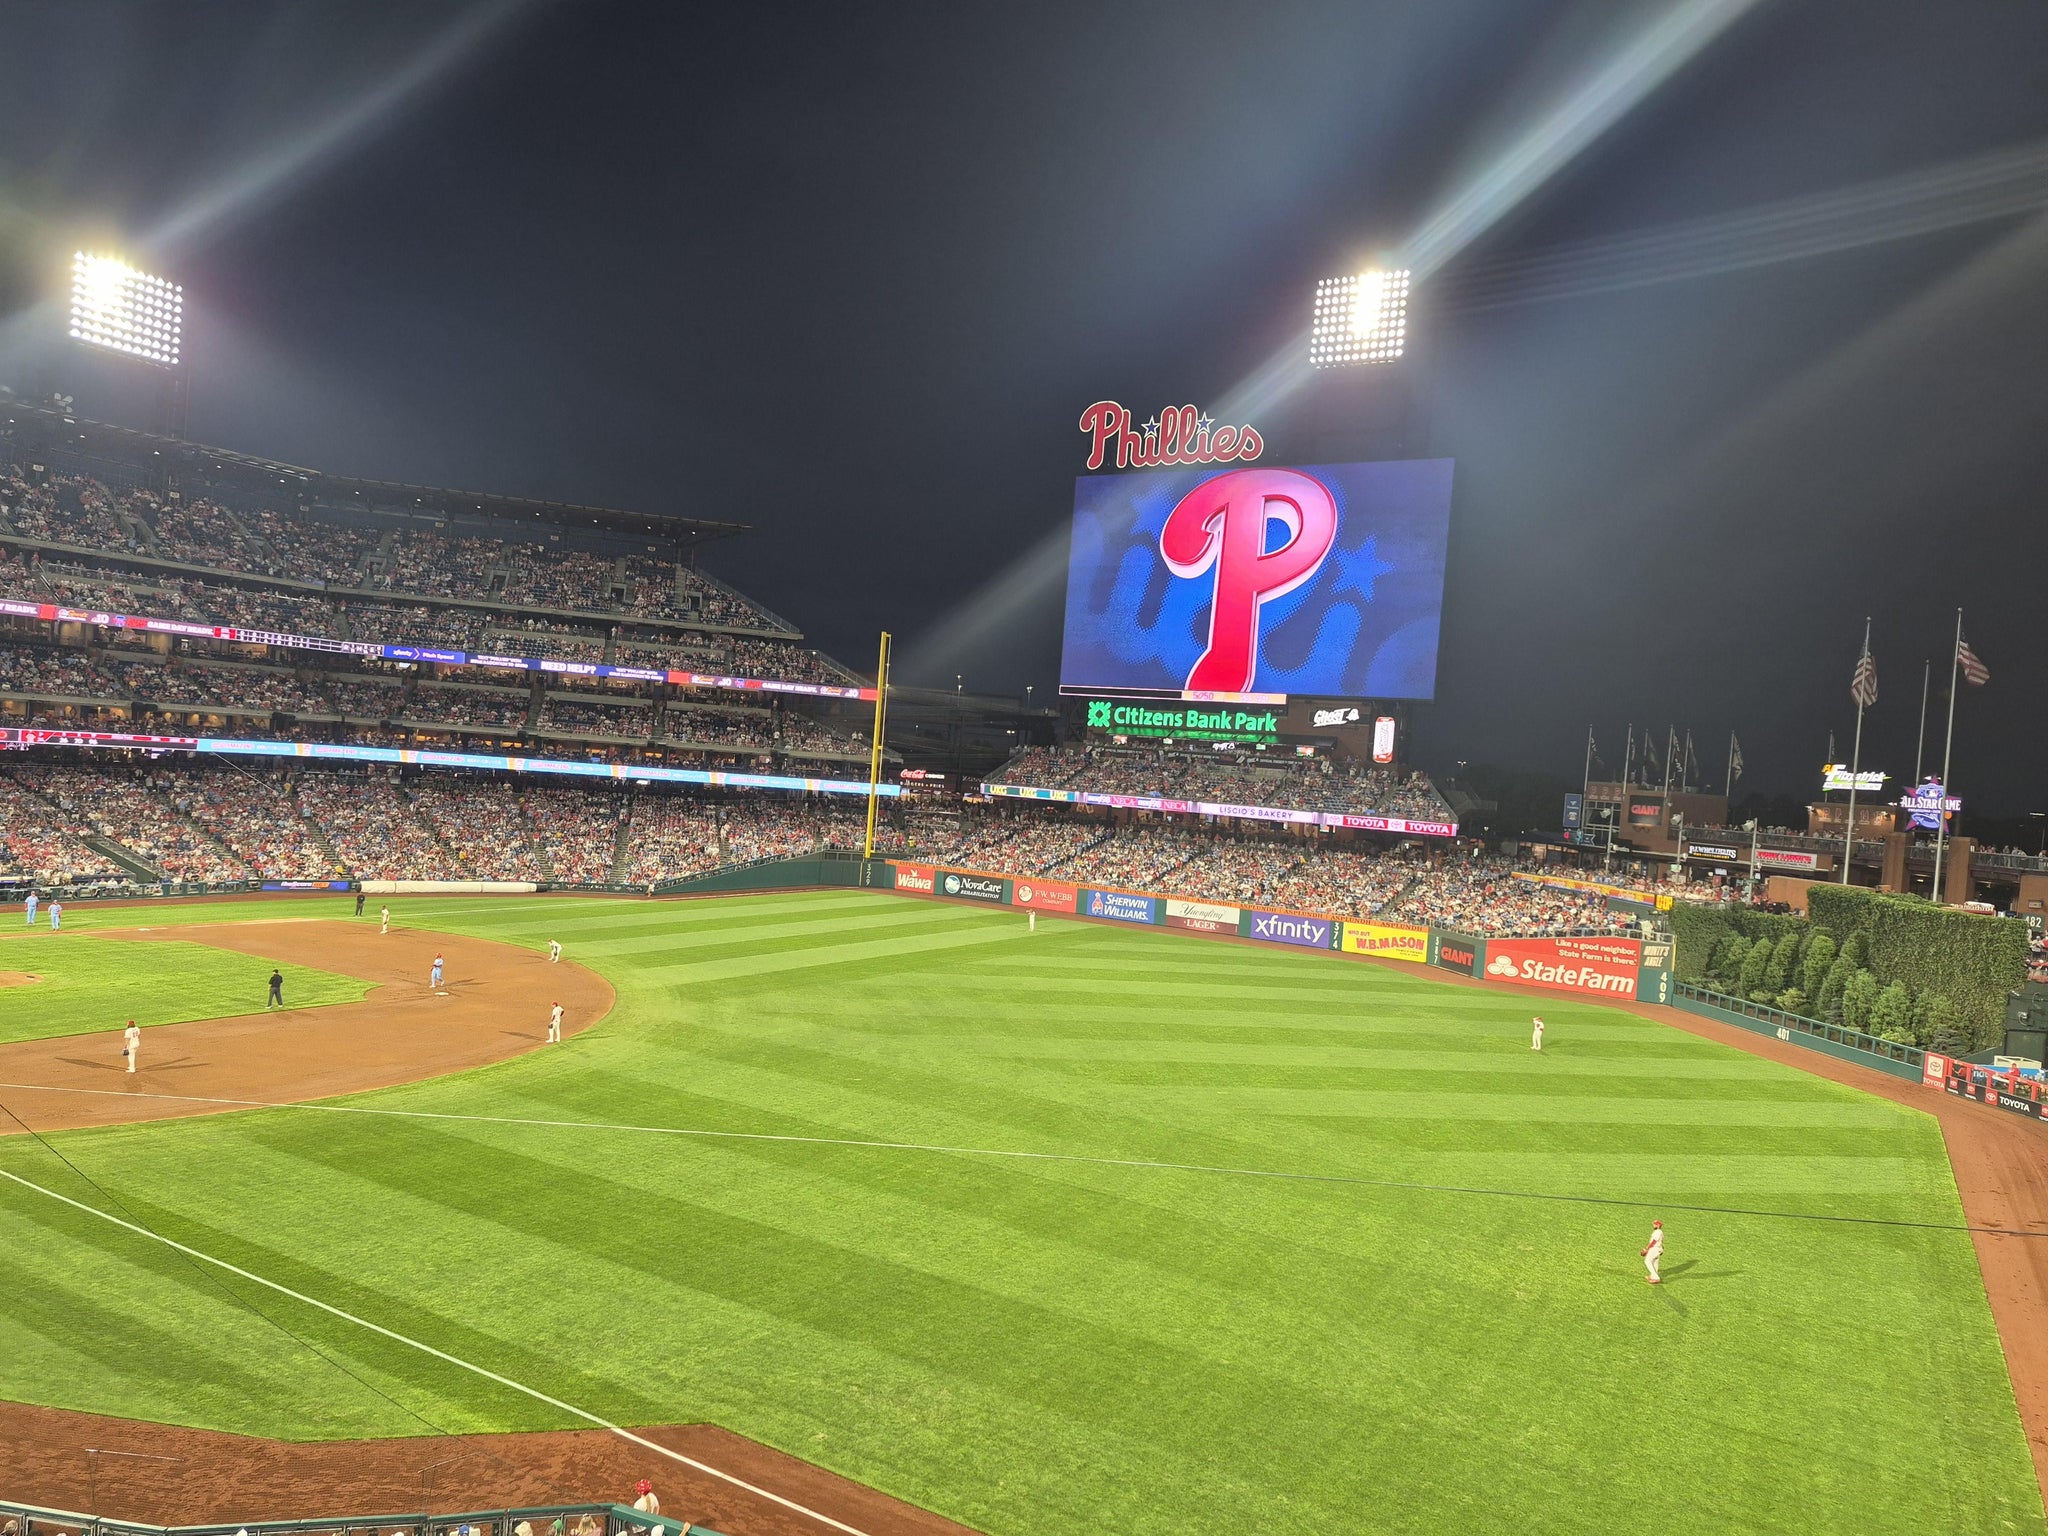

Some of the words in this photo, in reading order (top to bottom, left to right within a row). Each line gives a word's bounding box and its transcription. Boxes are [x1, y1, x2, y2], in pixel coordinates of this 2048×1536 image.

[1079, 400, 1264, 470] Phillies
[1159, 466, 1338, 692] P
[540, 660, 566, 672] NEED
[567, 662, 596, 675] HELP?
[1114, 706, 1183, 728] Citizens
[1186, 710, 1232, 730] Bank
[1234, 712, 1278, 732] Park
[1314, 708, 1351, 726] GHOST
[989, 784, 1008, 795] UKG
[1019, 787, 1038, 798] UKG
[1049, 790, 1068, 801] UKG
[1113, 796, 1136, 806] NECA
[1164, 801, 1186, 810] NECA
[1900, 796, 1916, 808] ALL
[1918, 796, 1938, 809] STAR
[1219, 806, 1255, 818] LISCIO'S
[1258, 809, 1294, 820] BAKERY
[1631, 804, 1660, 816] GIANT
[1346, 817, 1386, 828] TOYOTA
[1408, 822, 1449, 834] TOYOTA
[898, 873, 932, 890] Wawa
[960, 878, 1002, 893] NovaCare
[1050, 892, 1072, 902] WEBB
[1105, 894, 1148, 910] SHERWIN
[1186, 920, 1216, 930] LAGER
[1255, 915, 1326, 943] xfinity
[1555, 938, 1572, 948] Like
[1580, 943, 1599, 951] good
[1441, 946, 1474, 967] GIANT
[1558, 949, 1580, 958] State
[1582, 952, 1602, 961] Farm
[1659, 971, 1668, 1002] 409
[1776, 1027, 1790, 1041] 401
[1923, 1077, 1946, 1089] TOYOTA
[2000, 1096, 2030, 1112] TOYOTA
